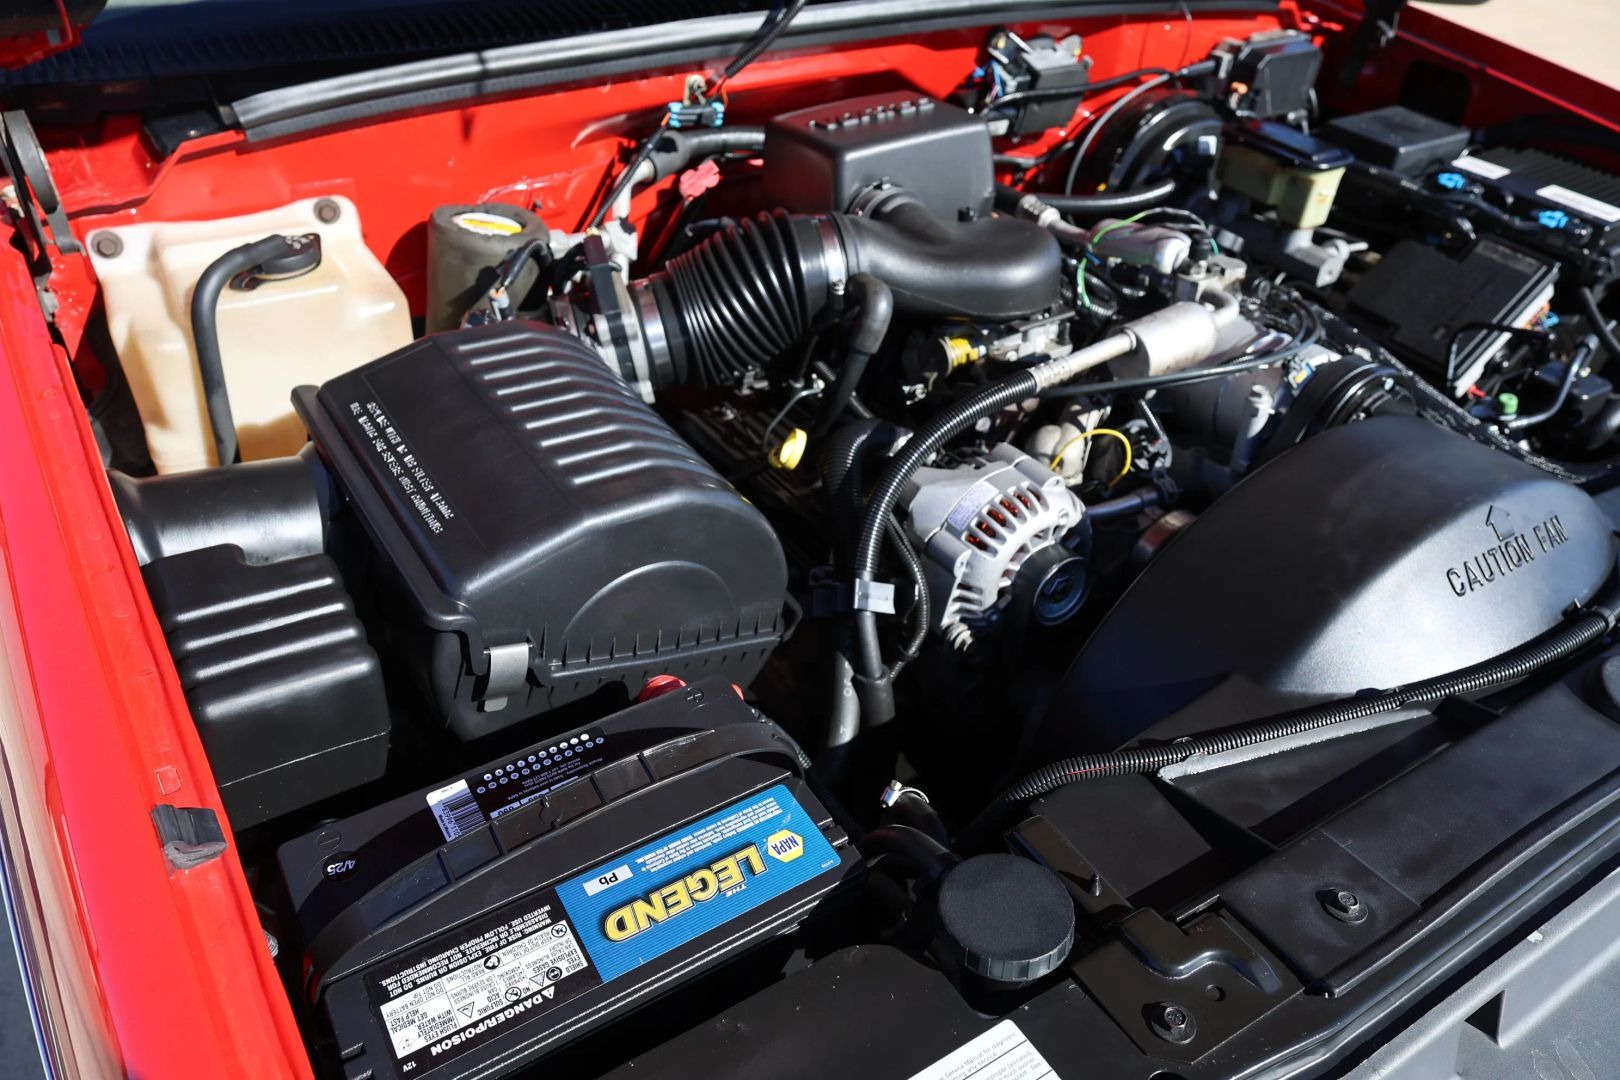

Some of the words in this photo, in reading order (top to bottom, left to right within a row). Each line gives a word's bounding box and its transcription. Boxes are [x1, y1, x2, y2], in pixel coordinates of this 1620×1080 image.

[1446, 533, 1535, 597] CAUTION
[1532, 515, 1568, 553] FAN
[770, 835, 799, 857] NAPA
[327, 860, 355, 876] 4/25
[597, 871, 619, 887] Pb
[602, 842, 769, 943] LEGEND
[726, 883, 747, 898] THE
[522, 904, 551, 921] INVERTED
[507, 916, 523, 928] USE.
[508, 912, 548, 934] DISASSEMBLE
[521, 917, 552, 935] WARNING:
[483, 923, 508, 939] FOLLOW
[498, 930, 509, 939] OR
[506, 931, 522, 942] RISK
[533, 930, 550, 942] REACH
[458, 934, 484, 950] PROPER
[462, 934, 499, 956] INCINERATE.
[497, 937, 507, 946] OF
[525, 937, 534, 945] OF
[528, 941, 540, 950] OUT
[539, 935, 553, 945] KEEP
[564, 942, 574, 950] CAN
[426, 946, 459, 965] CHARGING
[448, 951, 462, 962] NOT
[512, 949, 522, 958] THE
[549, 946, 564, 957] CAUSE
[549, 947, 577, 965] EXPLOSIVE
[447, 949, 482, 970] EXPLOSION
[524, 953, 550, 969] BLINDNESS
[400, 957, 449, 984] RECOMMENDED
[437, 965, 448, 974] OR
[531, 961, 550, 974] GASES
[564, 959, 584, 973] SHIELD
[378, 960, 427, 987] INSTRUCTIONS.
[460, 974, 470, 982] ALL
[470, 967, 485, 978] READ
[386, 979, 401, 991] FOR
[433, 981, 441, 989] DO
[467, 978, 485, 991] SEVERE
[484, 975, 493, 983] OR
[388, 986, 402, 997] NOT
[402, 981, 413, 991] DO
[421, 984, 433, 994] NOT
[435, 986, 444, 994] DO
[479, 980, 495, 992] CAUSE
[487, 986, 498, 995] CAN
[521, 985, 530, 994] NO
[408, 995, 424, 1007] OPEN
[424, 990, 435, 1000] NOT
[452, 987, 480, 1004] BLINDNESS
[486, 991, 500, 1002] ACID
[476, 997, 504, 1016] SULFURIC
[404, 1007, 419, 1019] HELP
[415, 1011, 428, 1022] GET
[436, 1008, 452, 1020] WITH
[387, 1014, 404, 1027] FAST.
[389, 1016, 416, 1034] MEDICAL
[414, 1015, 436, 1031] WATER.
[416, 1014, 455, 1038] IMMEDIATELY
[429, 993, 543, 1056] DANGER/POISON
[438, 1021, 457, 1035] FLUSH
[422, 1030, 439, 1043] EYES
[401, 1059, 416, 1072] 12V
